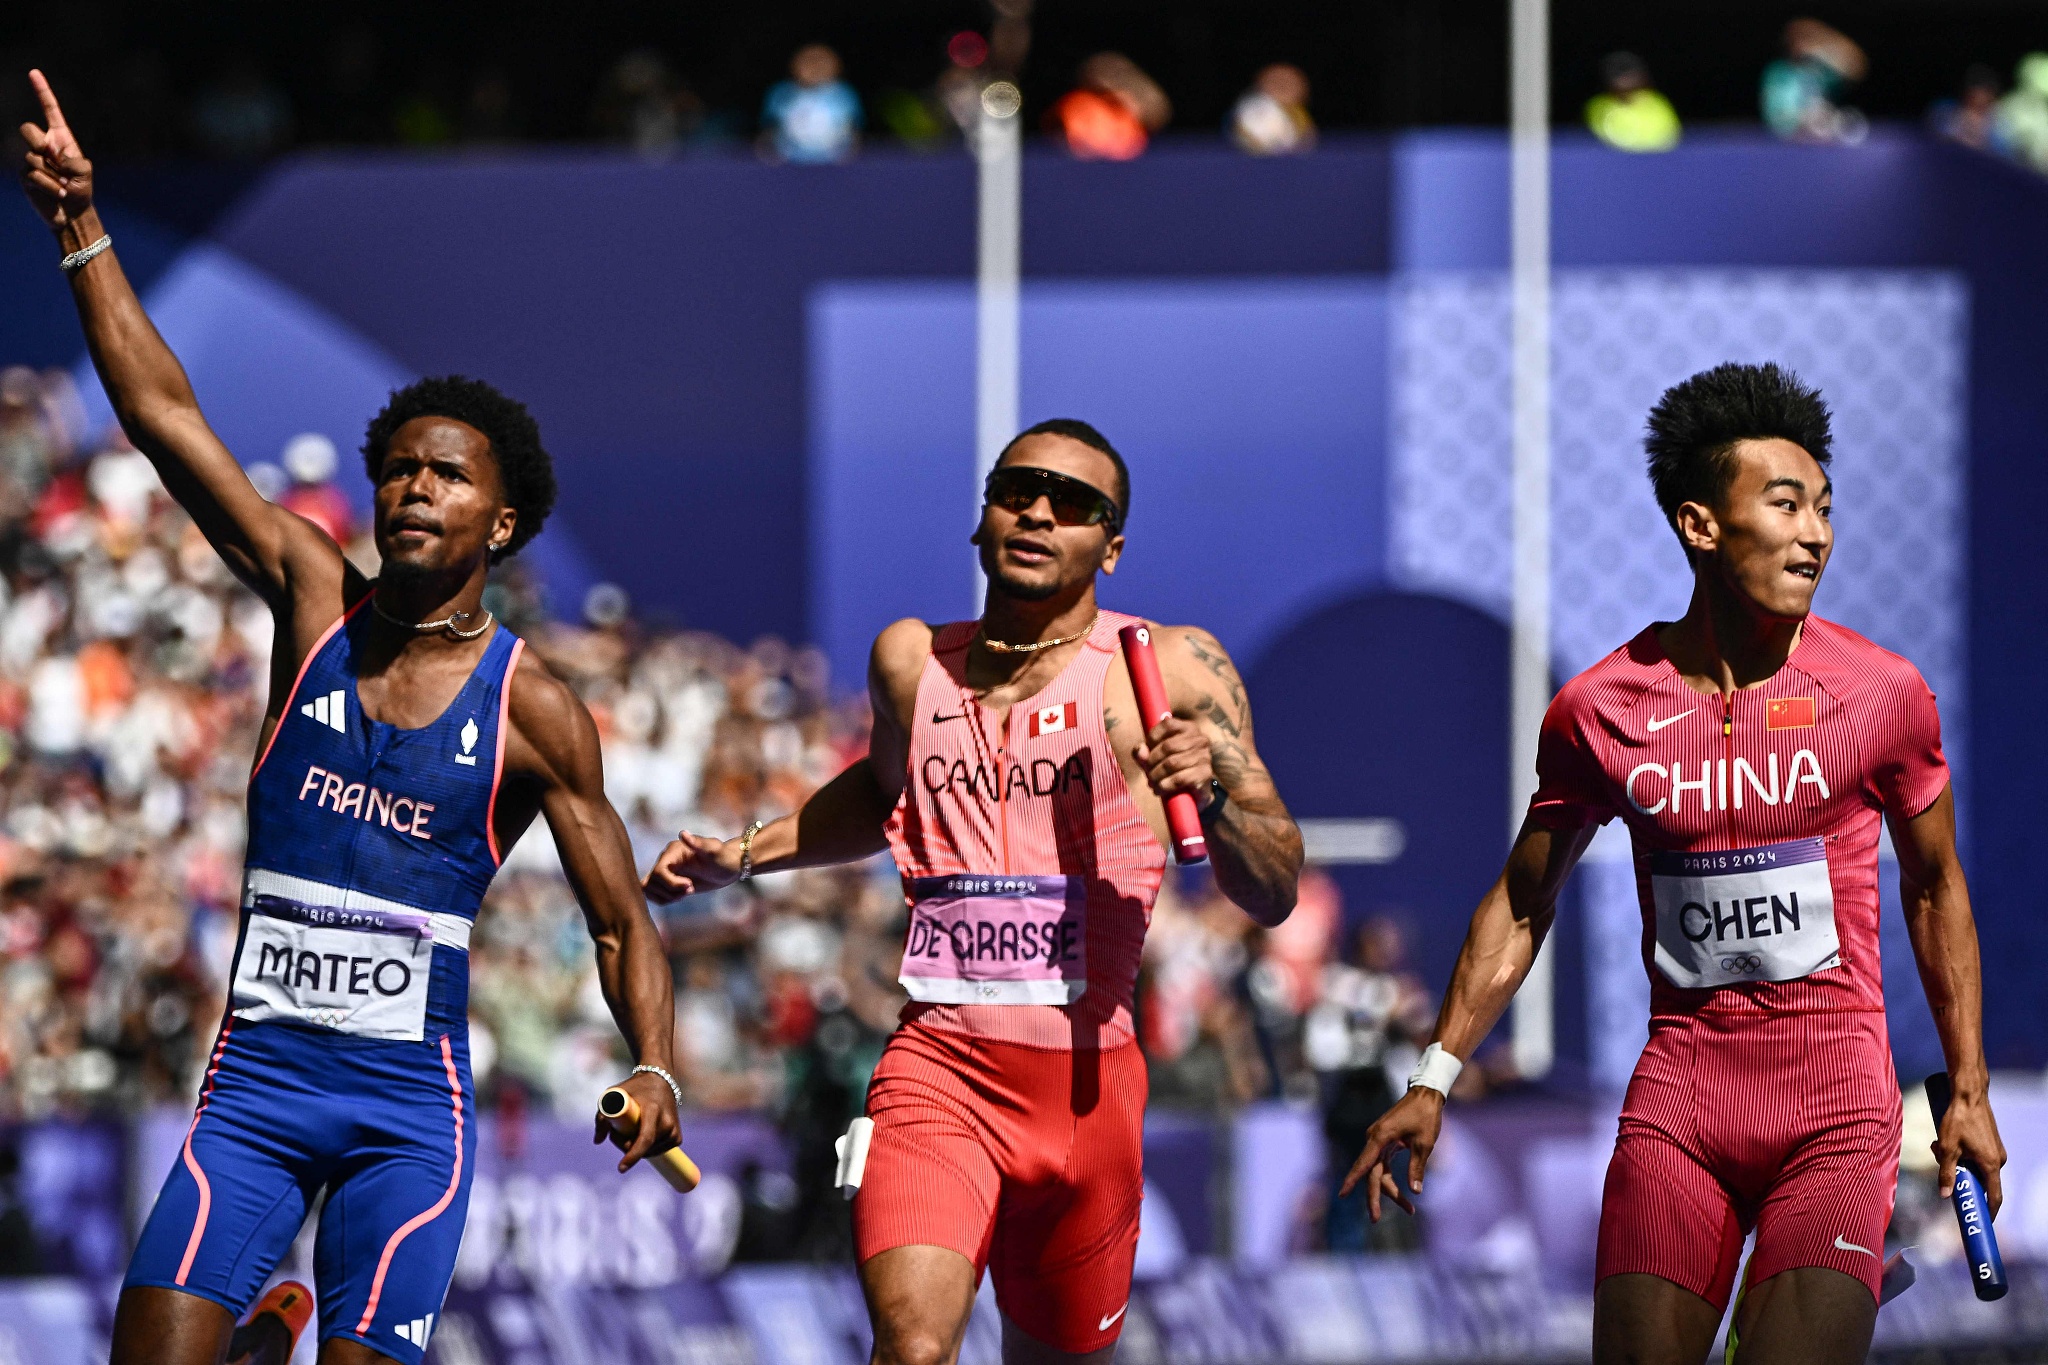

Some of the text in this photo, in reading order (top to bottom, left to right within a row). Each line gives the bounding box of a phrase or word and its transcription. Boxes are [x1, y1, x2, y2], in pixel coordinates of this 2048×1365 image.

[923, 755, 1090, 802] CANADA
[1626, 749, 1830, 815] CHINA
[298, 765, 436, 840] FRANCE
[1683, 850, 1777, 870] PARIS 2024
[947, 879, 1037, 893] PARIS 2024
[291, 905, 384, 928] PARIS 2024
[1678, 891, 1802, 943] CHEN
[909, 919, 1079, 962] DE GRASSE
[256, 942, 412, 996] MATEO
[1956, 1178, 1982, 1237] PARIS
[1978, 1262, 1992, 1280] 5
